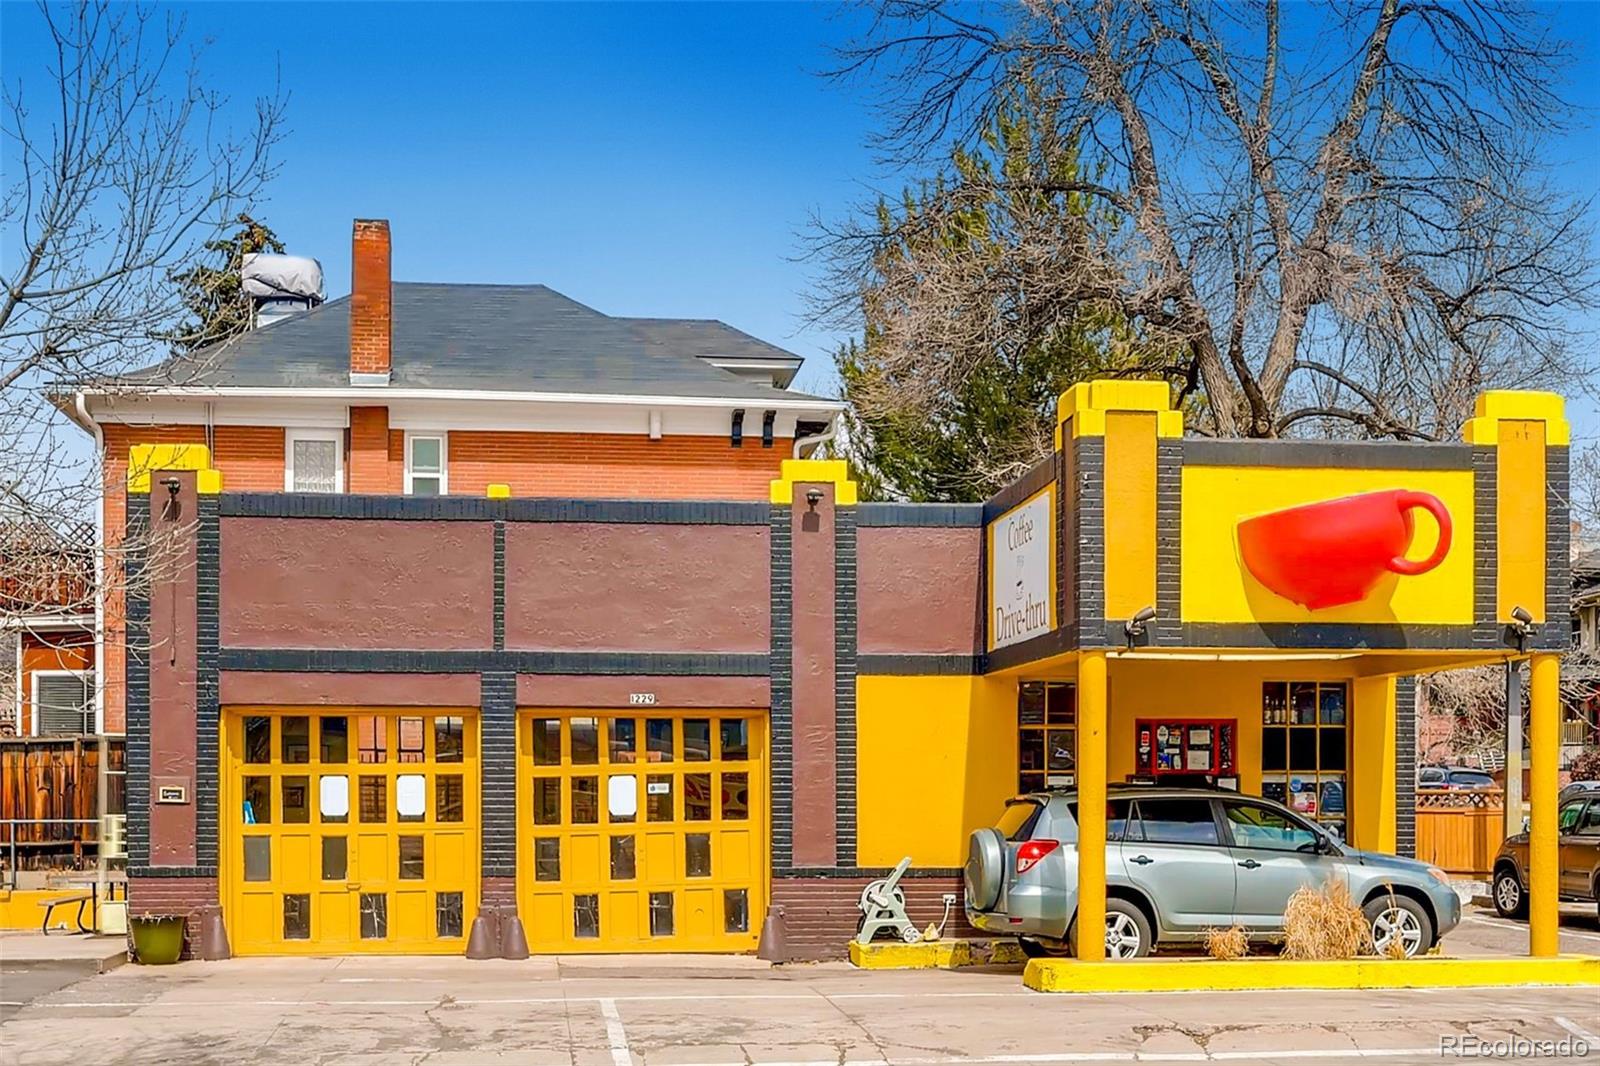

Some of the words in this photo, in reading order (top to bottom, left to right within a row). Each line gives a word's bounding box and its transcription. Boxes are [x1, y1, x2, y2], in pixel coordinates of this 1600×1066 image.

[1008, 513, 1033, 551] Coffee
[996, 594, 1047, 641] Drive-thru
[631, 694, 654, 704] 1229
